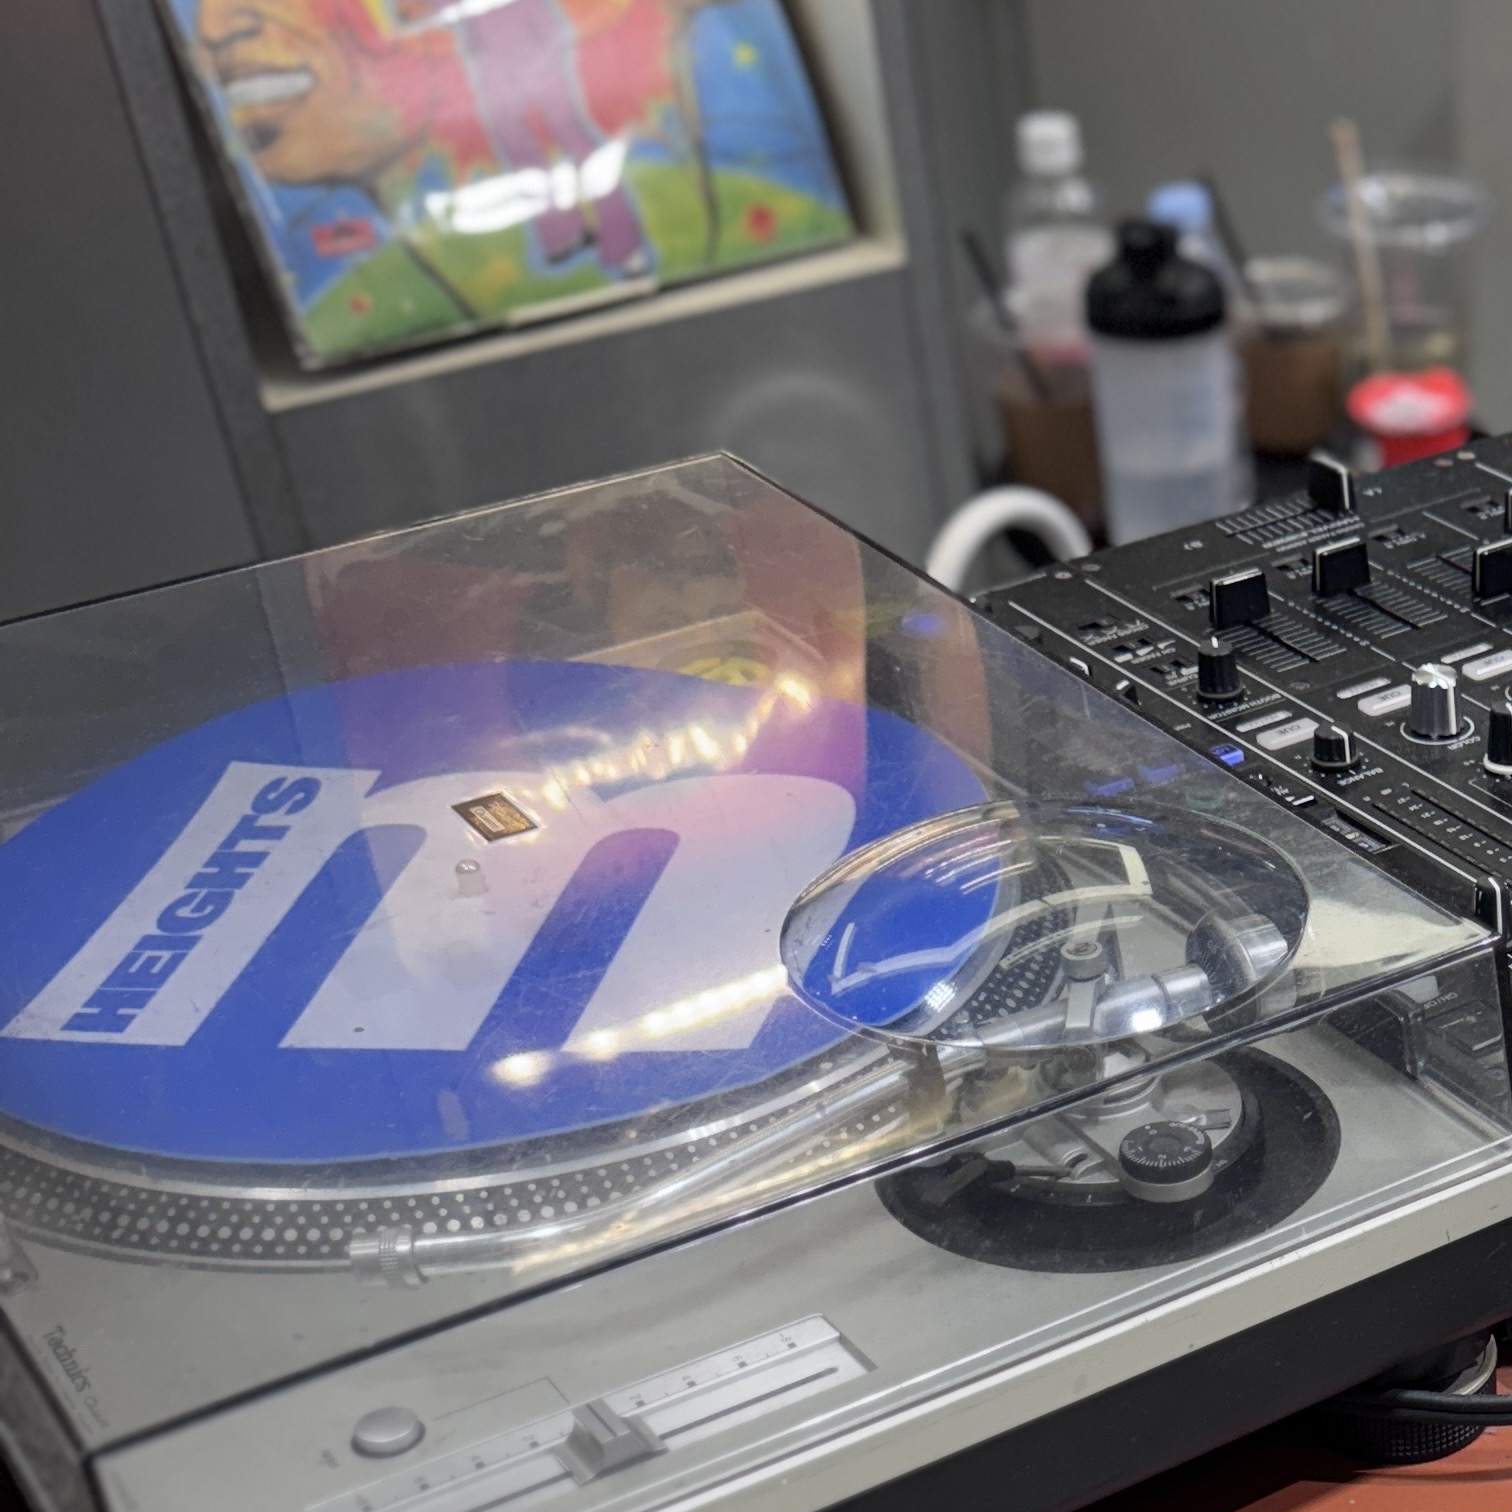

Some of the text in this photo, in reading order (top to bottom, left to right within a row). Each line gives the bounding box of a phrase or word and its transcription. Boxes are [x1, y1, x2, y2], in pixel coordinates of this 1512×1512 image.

[1377, 689, 1401, 703] CUE
[1277, 723, 1301, 737] CUE
[60, 775, 322, 1034] HEIGHTS
[43, 1324, 92, 1393] Technics
